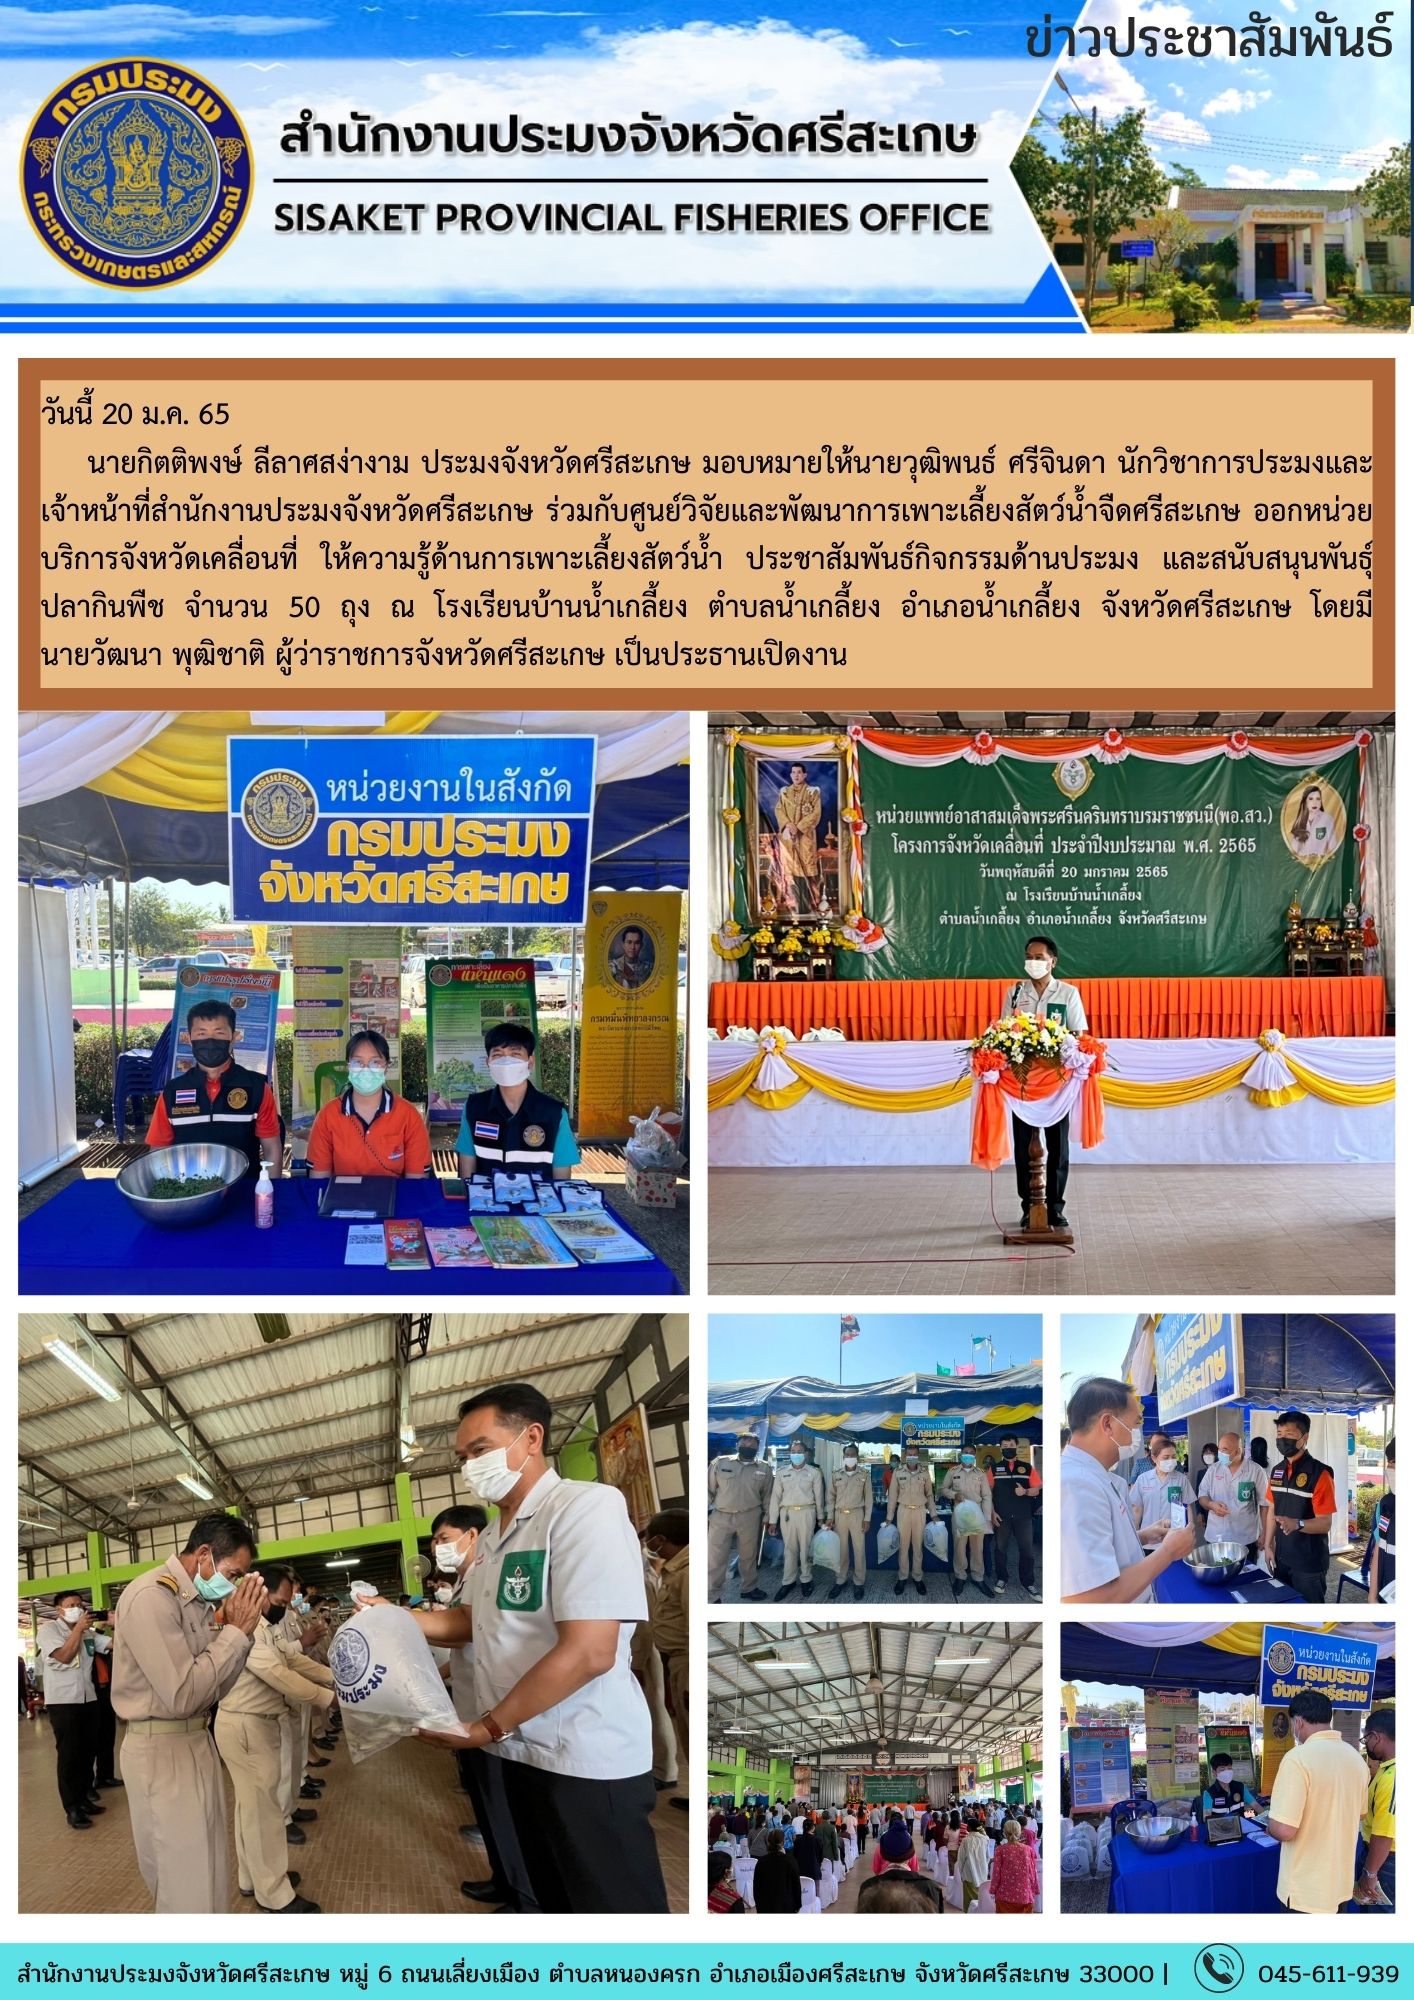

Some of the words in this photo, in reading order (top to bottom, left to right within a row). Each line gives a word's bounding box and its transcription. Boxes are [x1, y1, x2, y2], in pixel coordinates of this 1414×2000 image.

[326, 767, 572, 802] หน่วยงานในสังกัด
[327, 814, 570, 857] กรมประมง
[891, 828, 1044, 854] โครงการจังหวัดเคลื่อนที่
[1051, 834, 1176, 854] ประจำปีงบประมาณ
[1183, 838, 1213, 853] พ.ศ.
[1219, 837, 1257, 853] 2565
[979, 859, 1055, 880] วันพฤหัสบดีที่
[1061, 866, 1077, 878] 20
[1084, 867, 1129, 878] มกราคม
[1136, 866, 1168, 878] 2565
[259, 859, 570, 904] จังหวัดศรีสะเกษ
[1006, 891, 1017, 901] ณ
[1023, 883, 1142, 901] โรงเรียนบ้านน้ำเกลี้ยง
[939, 906, 1020, 925] ตำบลน้ำเกลี้ยง
[1027, 906, 1112, 925] อำเภอน้ำเกลี้ยง
[1118, 910, 1207, 925] จังหวัดศรีสะเกษ
[1298, 1646, 1371, 1666] หน่วยงานในสังกัด
[1296, 1665, 1370, 1685] กรมประมง
